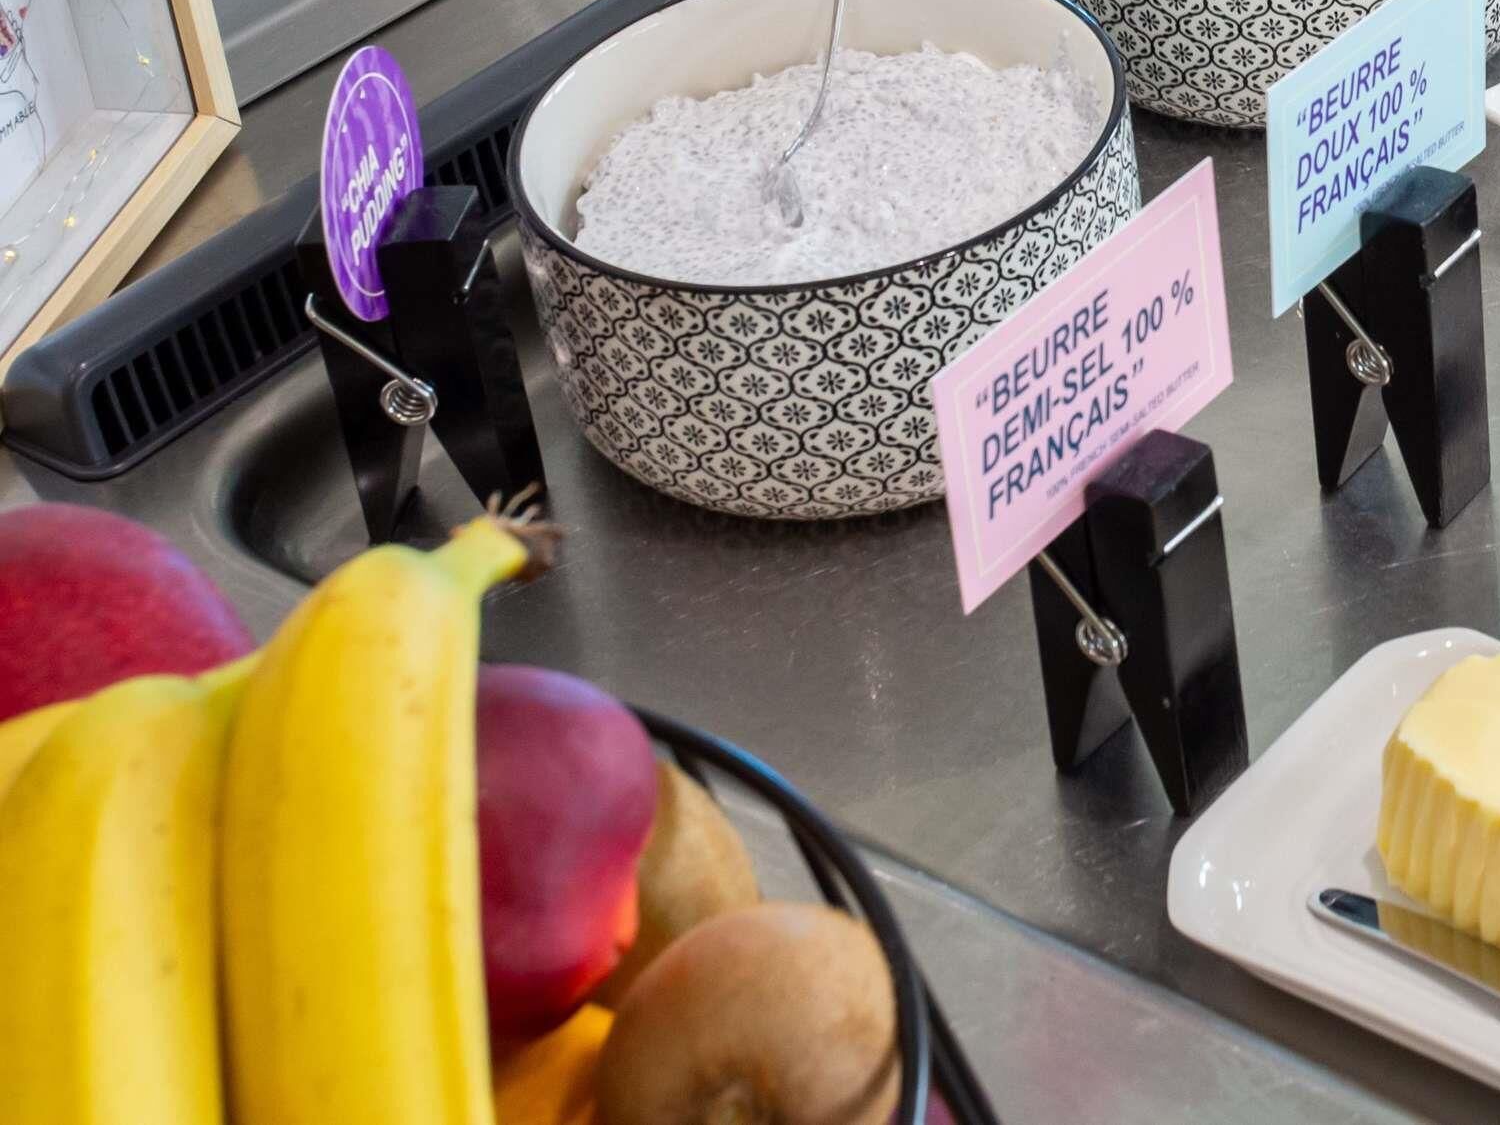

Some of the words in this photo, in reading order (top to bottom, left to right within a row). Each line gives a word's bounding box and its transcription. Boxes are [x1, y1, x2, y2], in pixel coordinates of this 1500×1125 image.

[1296, 110, 1363, 191] DOUX
[1368, 81, 1403, 134] 100
[1410, 61, 1428, 105] %
[981, 342, 1115, 475] DEMI-SEL
[1121, 298, 1164, 355] 100
[1170, 269, 1194, 318] %
